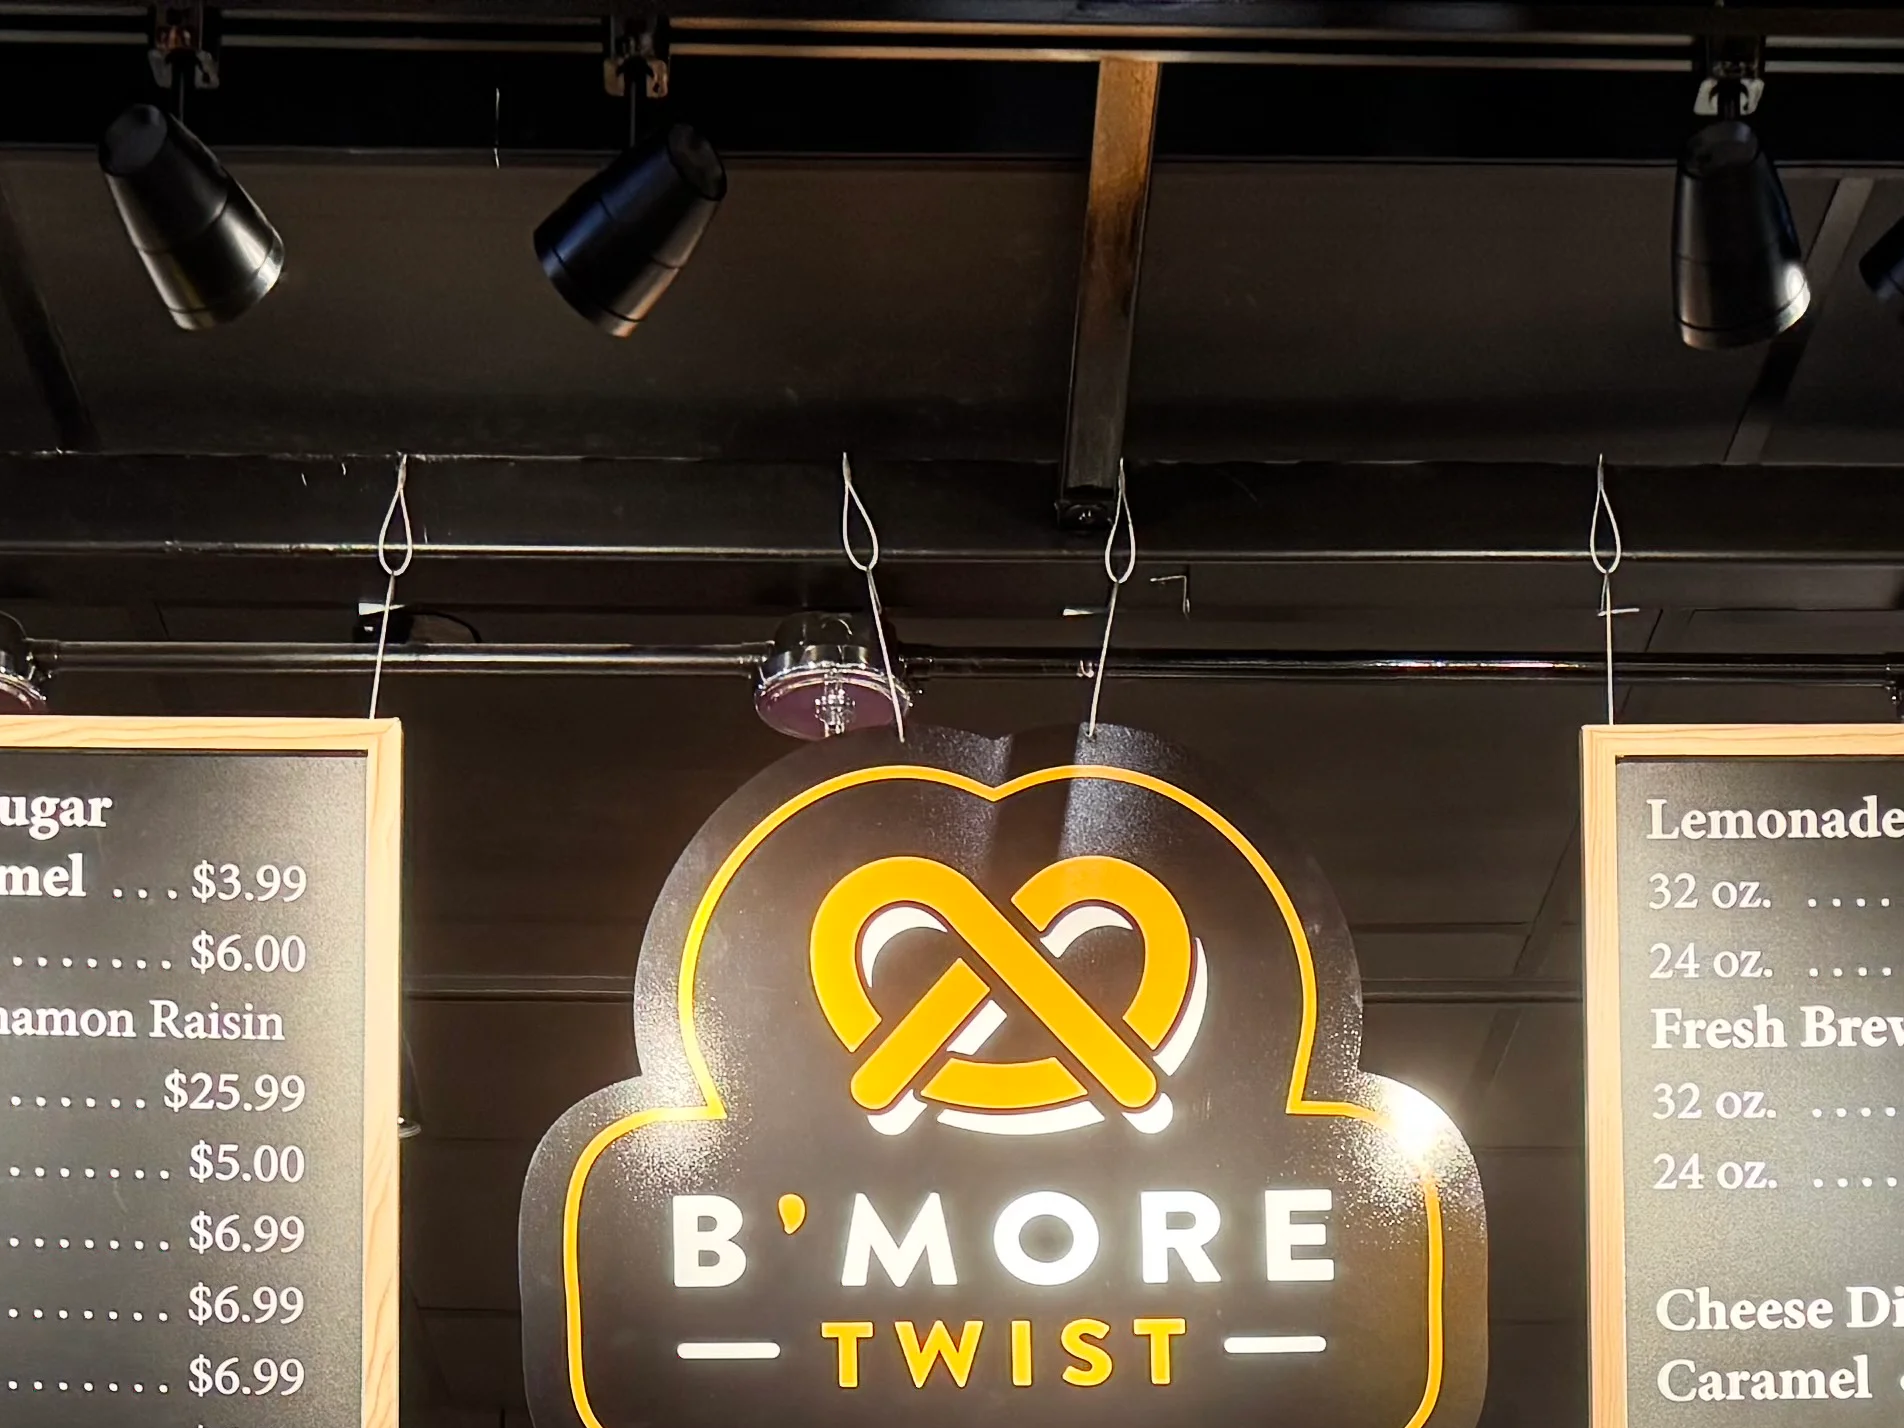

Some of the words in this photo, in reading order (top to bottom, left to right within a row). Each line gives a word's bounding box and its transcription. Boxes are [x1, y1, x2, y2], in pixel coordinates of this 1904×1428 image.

[192, 860, 306, 903] $3.99
[1650, 873, 1697, 909] 32
[1712, 882, 1770, 908] oz.
[191, 930, 305, 974] $6.00
[1650, 943, 1700, 978] 24
[1714, 951, 1772, 977] oz.
[149, 1000, 285, 1040] Raisin
[1651, 1004, 1787, 1048] Fresh
[164, 1069, 305, 1112] $25.99
[1653, 1083, 1702, 1119] 32
[1716, 1092, 1776, 1118] oz.
[190, 1140, 304, 1182] $5.00
[1654, 1154, 1704, 1189] 24
[1717, 1162, 1777, 1189] oz.
[190, 1211, 304, 1254] $6.99
[672, 1189, 1334, 1288] B'MORE
[189, 1282, 303, 1325] $6.99
[1657, 1287, 1833, 1330] Cheese
[821, 1318, 1187, 1389] TWIST
[189, 1354, 304, 1397] $6.99
[1658, 1355, 1872, 1401] Caramel
